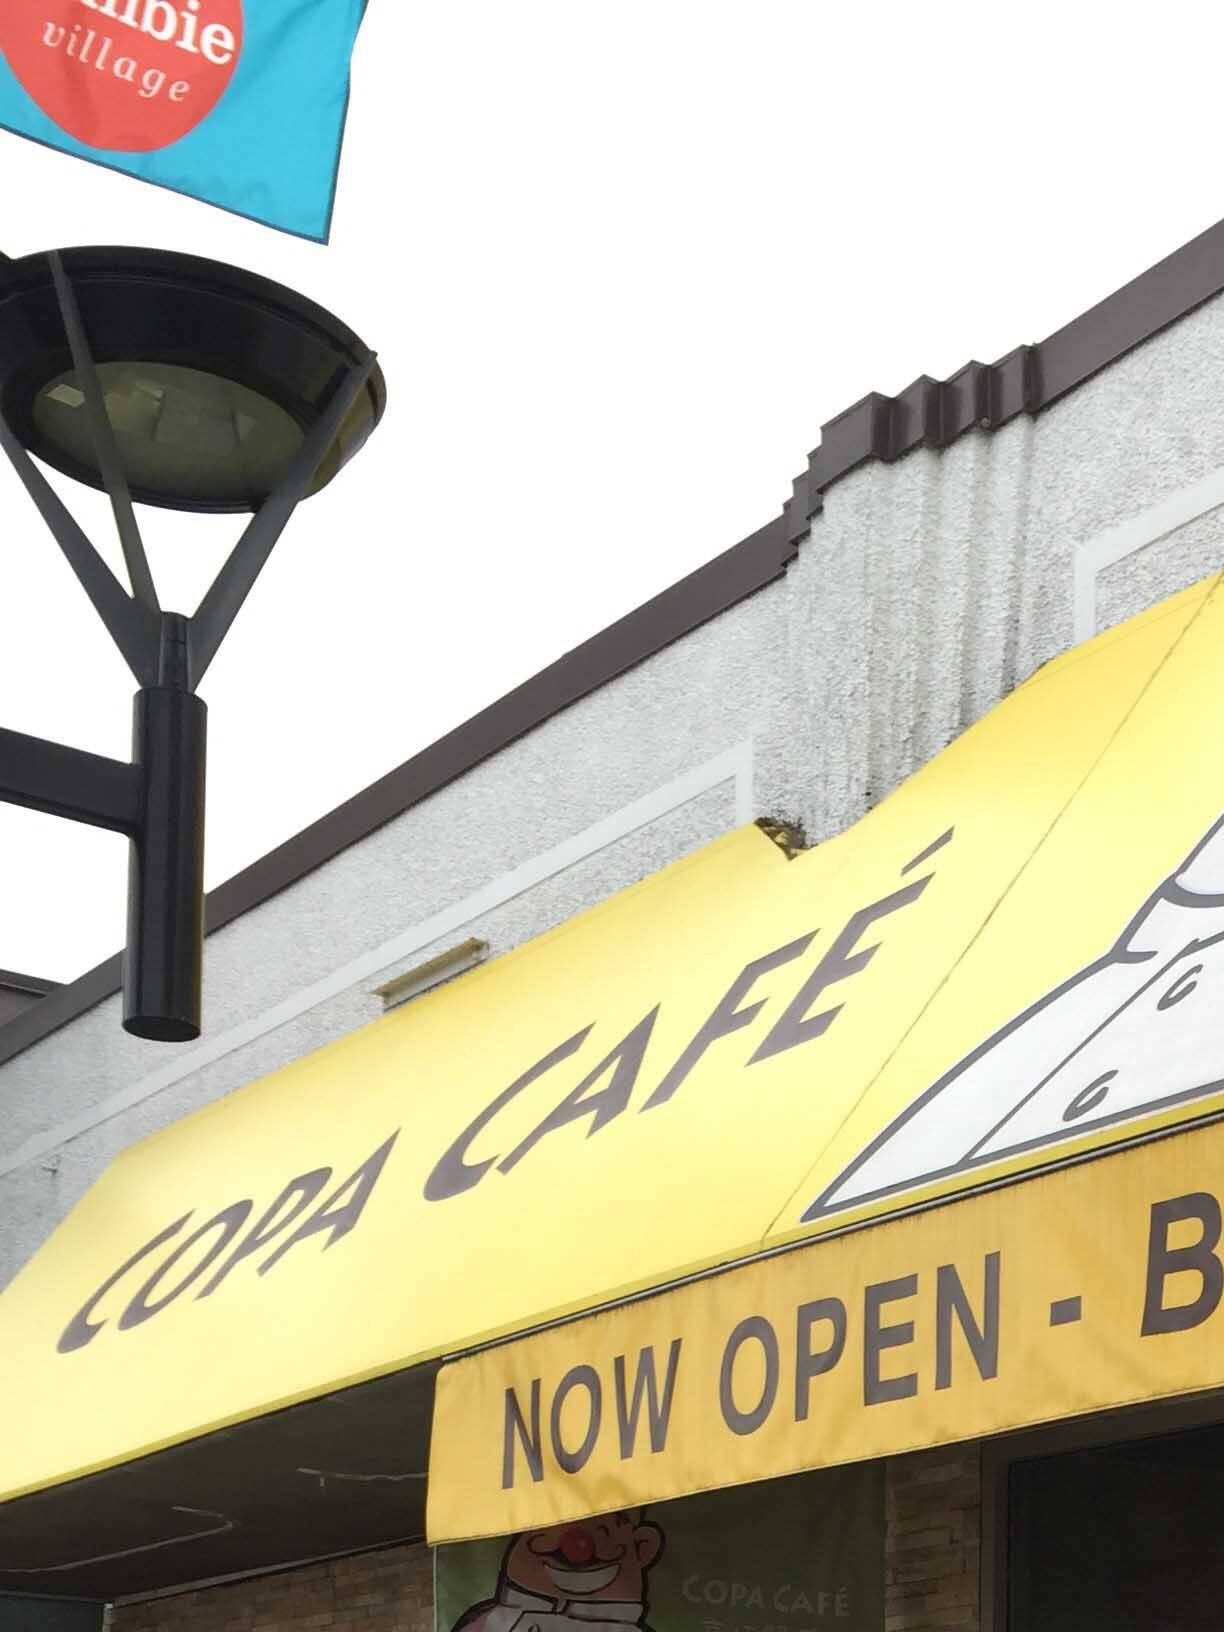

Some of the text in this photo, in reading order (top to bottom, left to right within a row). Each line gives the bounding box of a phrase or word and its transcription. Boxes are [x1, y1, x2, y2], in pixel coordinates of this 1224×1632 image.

[43, 22, 190, 101] village
[57, 825, 955, 1355] COPA CAFÉ
[500, 1338, 682, 1491] NOW
[718, 1251, 1000, 1437] OPEN
[681, 1573, 852, 1618] COPA CAFÉ
